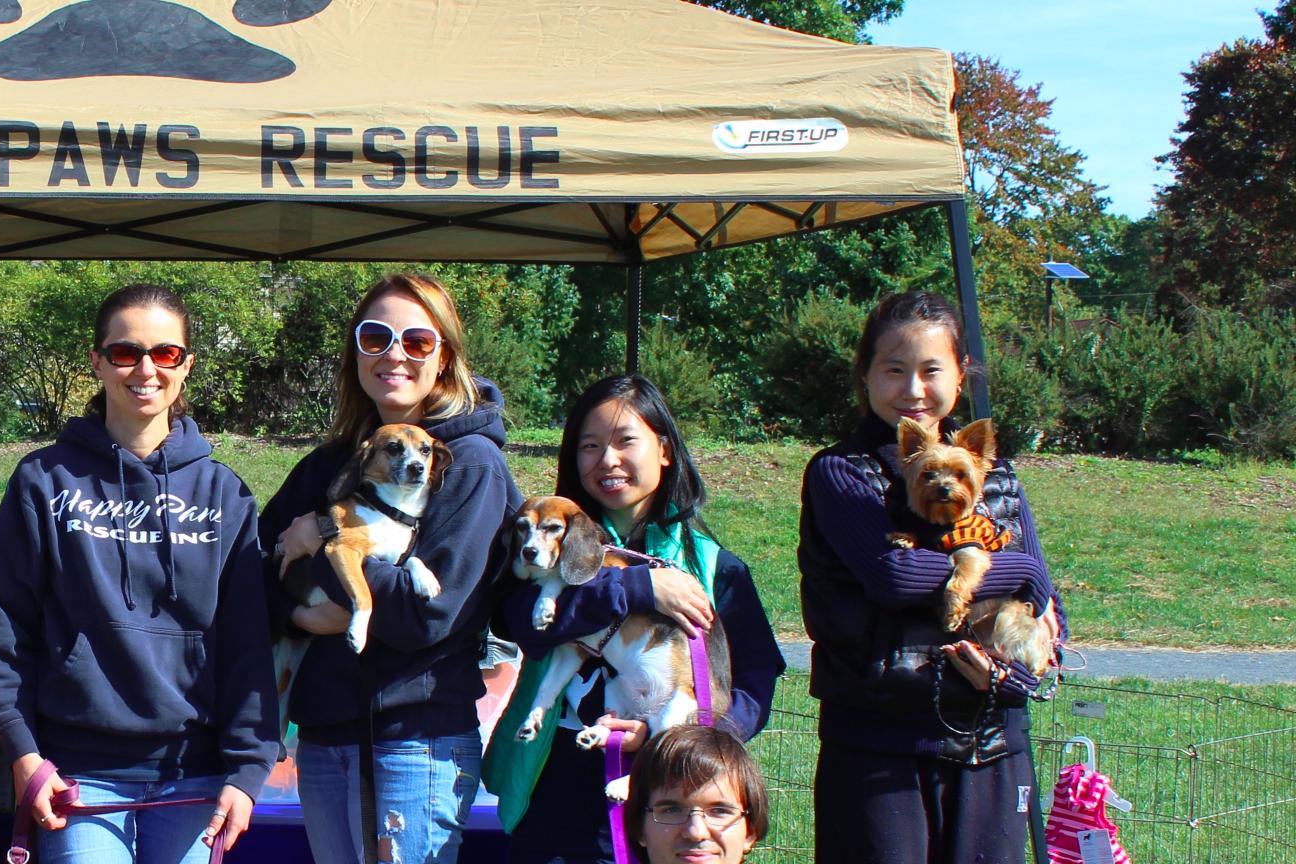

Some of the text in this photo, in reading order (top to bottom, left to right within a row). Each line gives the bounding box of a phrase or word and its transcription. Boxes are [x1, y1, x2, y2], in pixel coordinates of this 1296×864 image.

[261, 124, 561, 191] RESCUE
[49, 489, 151, 528] Happy
[67, 518, 219, 545] RESCUE INC
